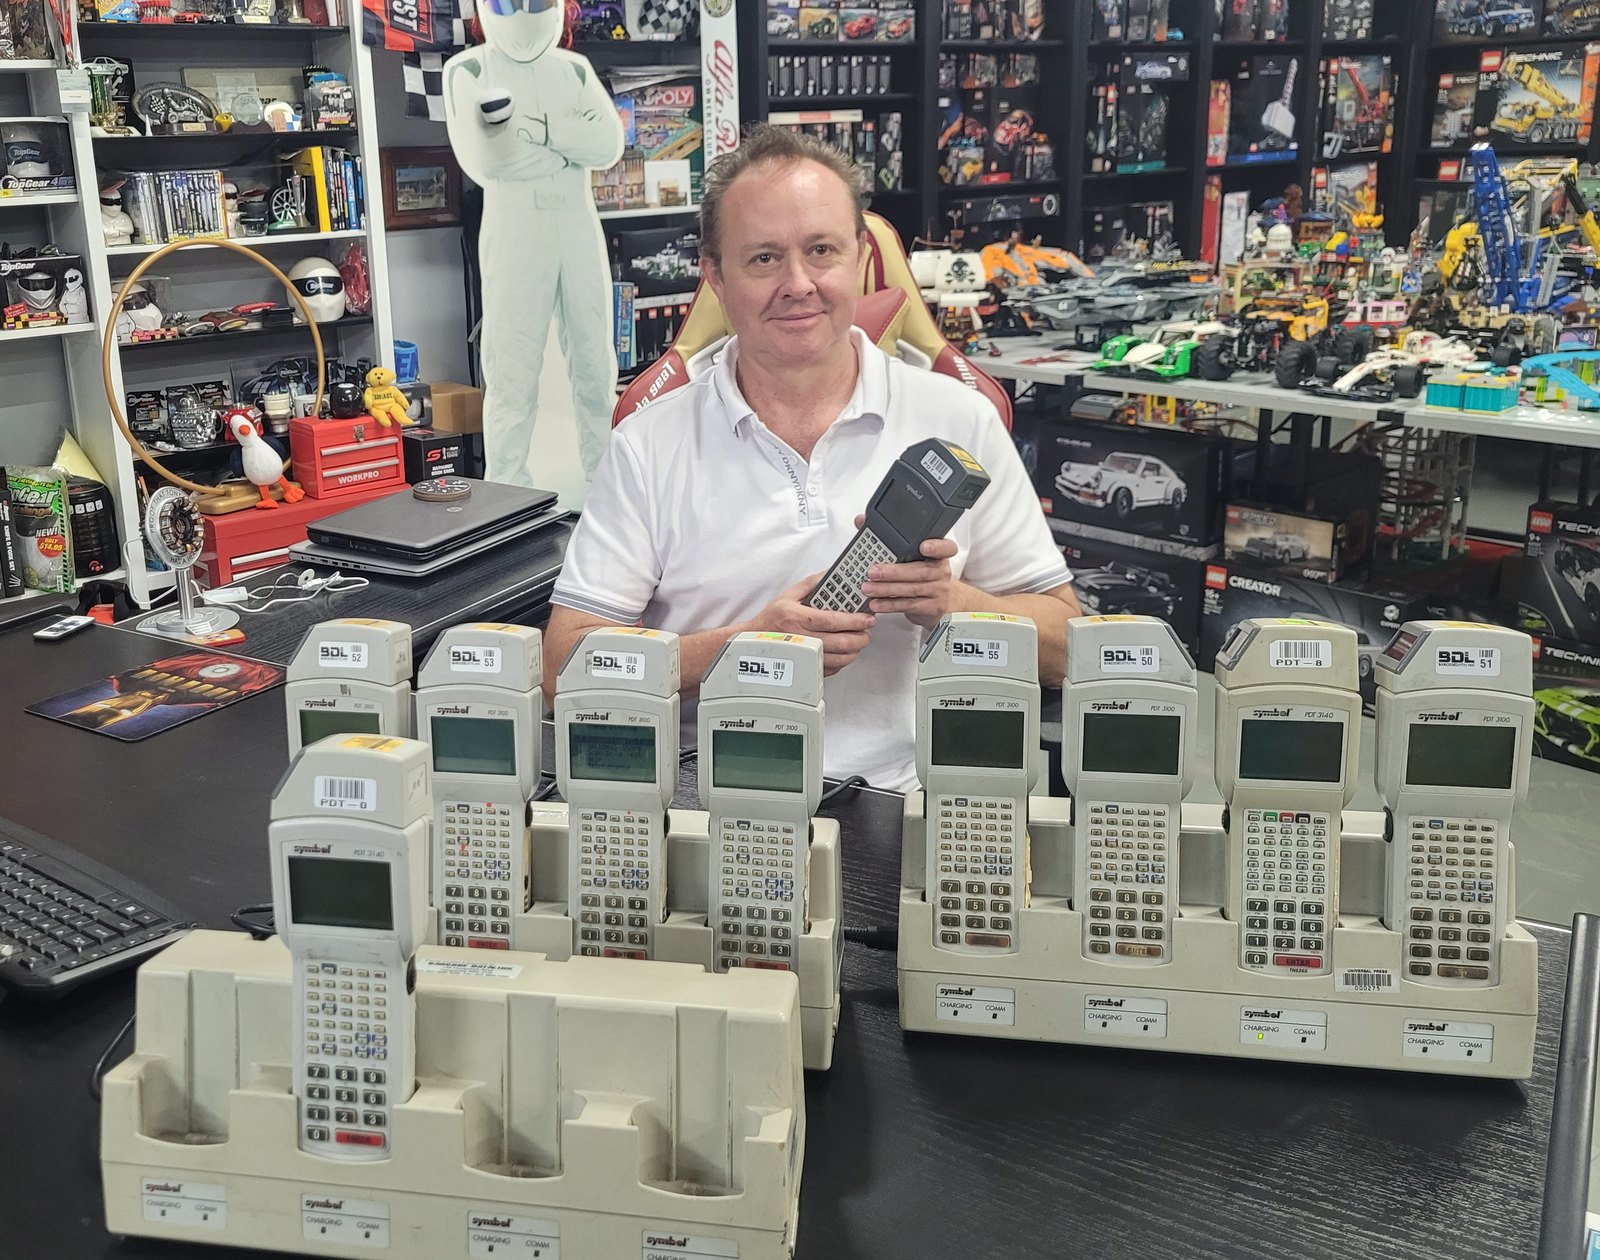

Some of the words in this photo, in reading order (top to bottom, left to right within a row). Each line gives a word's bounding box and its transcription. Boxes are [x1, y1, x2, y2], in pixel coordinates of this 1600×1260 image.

[8, 178, 50, 189] TopGear
[0, 262, 36, 272] TopGear
[338, 470, 380, 484] WORKPRO
[154, 491, 166, 504] THAT
[35, 526, 58, 538] NEW!
[1228, 575, 1281, 598] CREATOR
[320, 646, 348, 658] BDL
[352, 653, 362, 662] 52
[953, 642, 984, 654] BDL
[988, 650, 999, 660] 55
[1545, 646, 1600, 666] TECHNI
[452, 651, 480, 662] BDL
[484, 658, 494, 667] 53
[1104, 650, 1136, 662] BDL
[1142, 656, 1153, 666] 50
[1439, 651, 1474, 663] BDL
[1480, 658, 1492, 668] 51
[593, 656, 622, 668] BDL
[626, 664, 636, 674] 56
[739, 660, 769, 674] BDL
[773, 671, 784, 680] 57
[304, 698, 336, 708] symbol
[939, 698, 976, 707] symbol
[1092, 701, 1130, 711] symbol
[437, 706, 470, 715] symbol
[1253, 708, 1290, 718] symbol
[576, 711, 610, 721] symbol
[1418, 712, 1460, 722] symbol
[719, 719, 756, 729] symbol
[294, 844, 331, 854] symbol
[940, 988, 973, 996] symbol
[940, 1001, 972, 1009] CHARGING
[1088, 998, 1123, 1008] symbol
[1088, 1012, 1122, 1020] CHARGING
[1244, 1010, 1280, 1018] symbol
[1244, 1024, 1279, 1032] CHARGING
[1408, 1023, 1446, 1032] symbol
[1408, 1038, 1444, 1046] CHARGING
[146, 1182, 181, 1192] symbol
[306, 1200, 342, 1210] symbol
[306, 1216, 342, 1226] CHARGING
[356, 1221, 380, 1230] COMM
[472, 1217, 510, 1228] symbol
[473, 1234, 510, 1244] CHARGING
[526, 1240, 550, 1248] COMM
[646, 1236, 686, 1247] symbol
